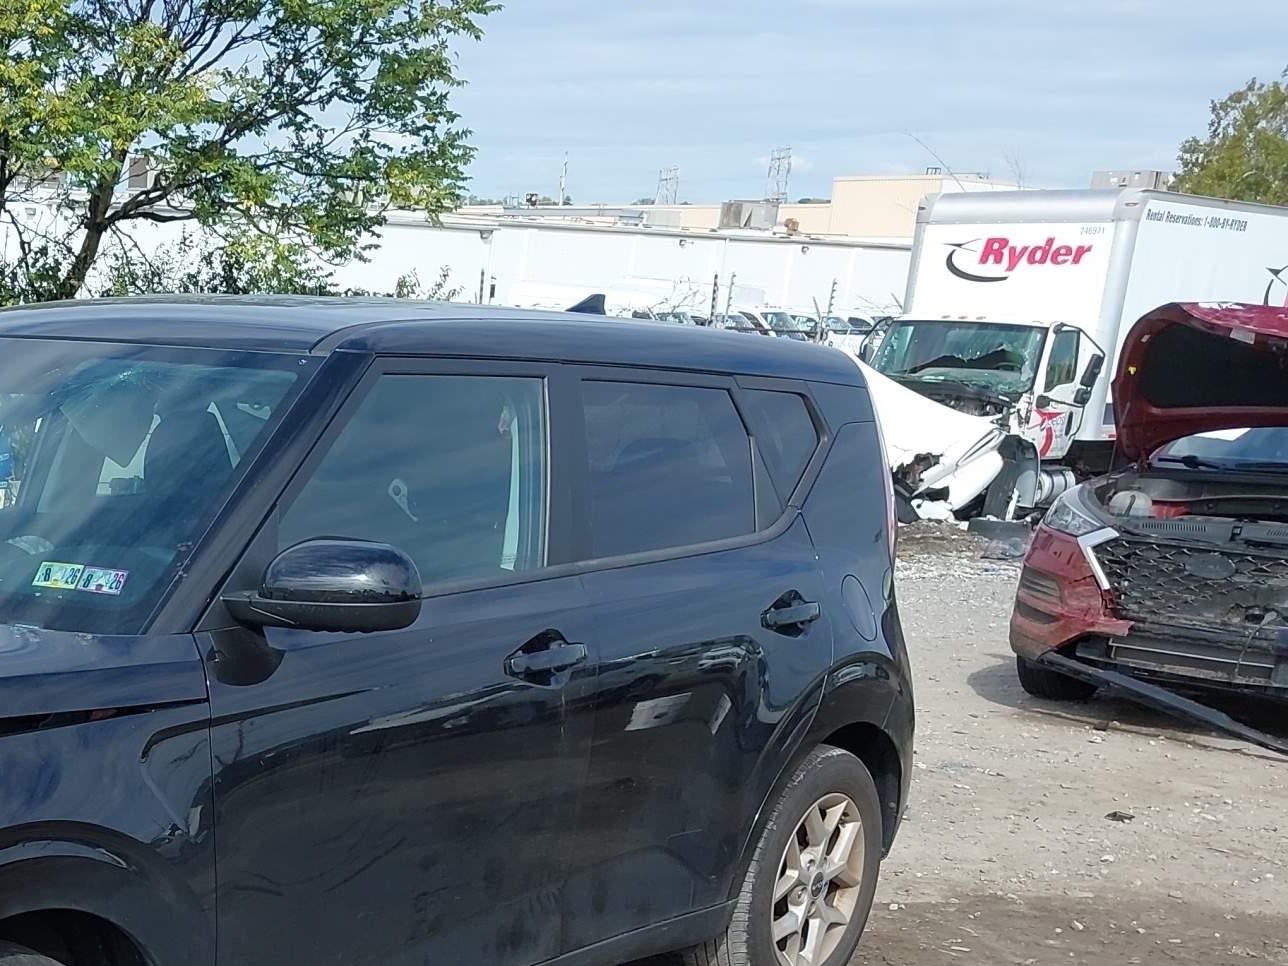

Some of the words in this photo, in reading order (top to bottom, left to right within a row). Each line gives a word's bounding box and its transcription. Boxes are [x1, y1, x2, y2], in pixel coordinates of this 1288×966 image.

[1145, 208, 1165, 222] Rental
[978, 236, 1094, 272] Ryder
[65, 567, 80, 584] 26
[109, 573, 125, 590] 26
